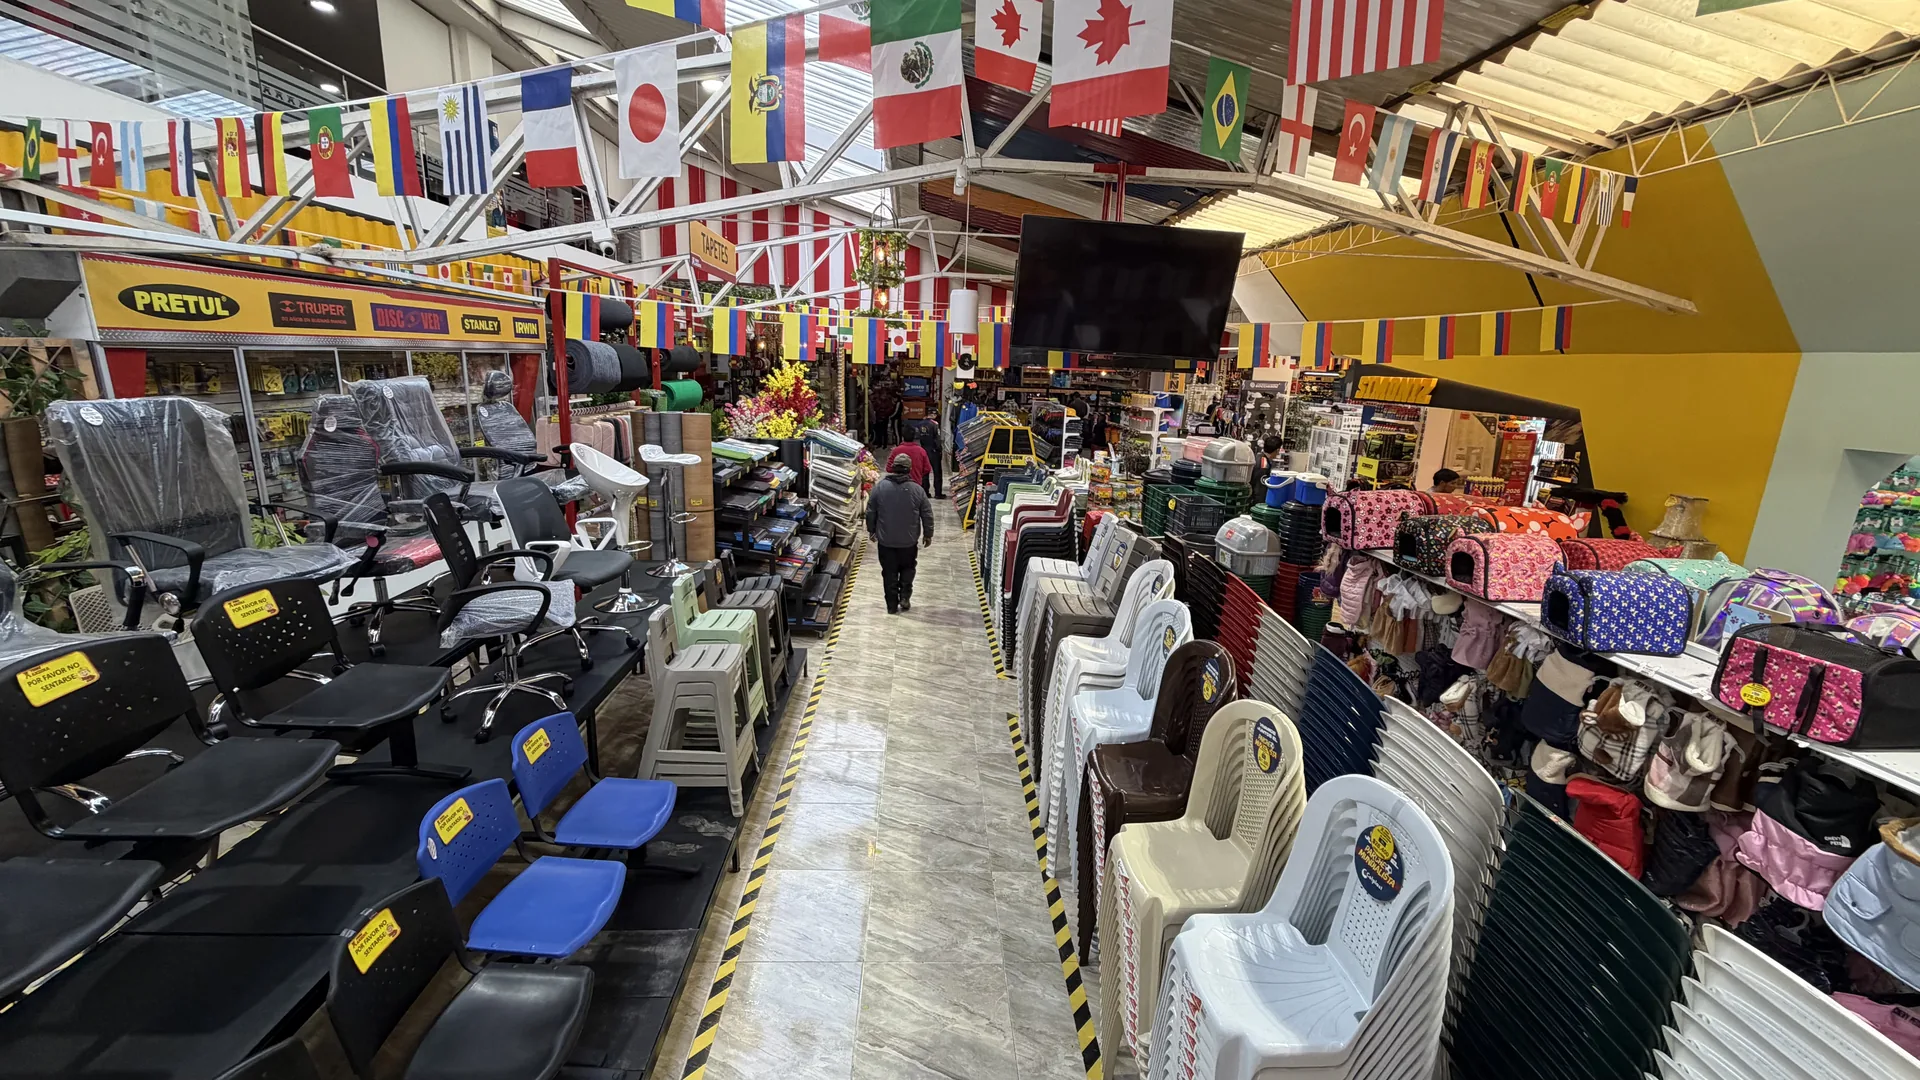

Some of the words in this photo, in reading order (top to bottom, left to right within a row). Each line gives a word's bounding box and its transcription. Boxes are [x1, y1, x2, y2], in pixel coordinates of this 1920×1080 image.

[701, 232, 729, 264] TAPETES
[133, 290, 230, 316] PRETUL
[296, 301, 345, 316] TRUPER
[464, 319, 499, 332] STANLEY
[515, 321, 538, 335] IRWIN
[1355, 376, 1438, 404] SIMONIZ
[240, 606, 264, 618] SENTARSE
[242, 601, 259, 610] FAVOR
[27, 677, 43, 687] POR
[42, 667, 67, 681] FAVOR
[67, 662, 80, 671] NO
[40, 673, 77, 692] SENTARSE
[1358, 848, 1396, 888] MUNDIALISTA
[354, 943, 365, 955] POR
[363, 927, 380, 945] FAVOR
[378, 919, 387, 930] NO
[363, 931, 387, 957] SENTARSE
